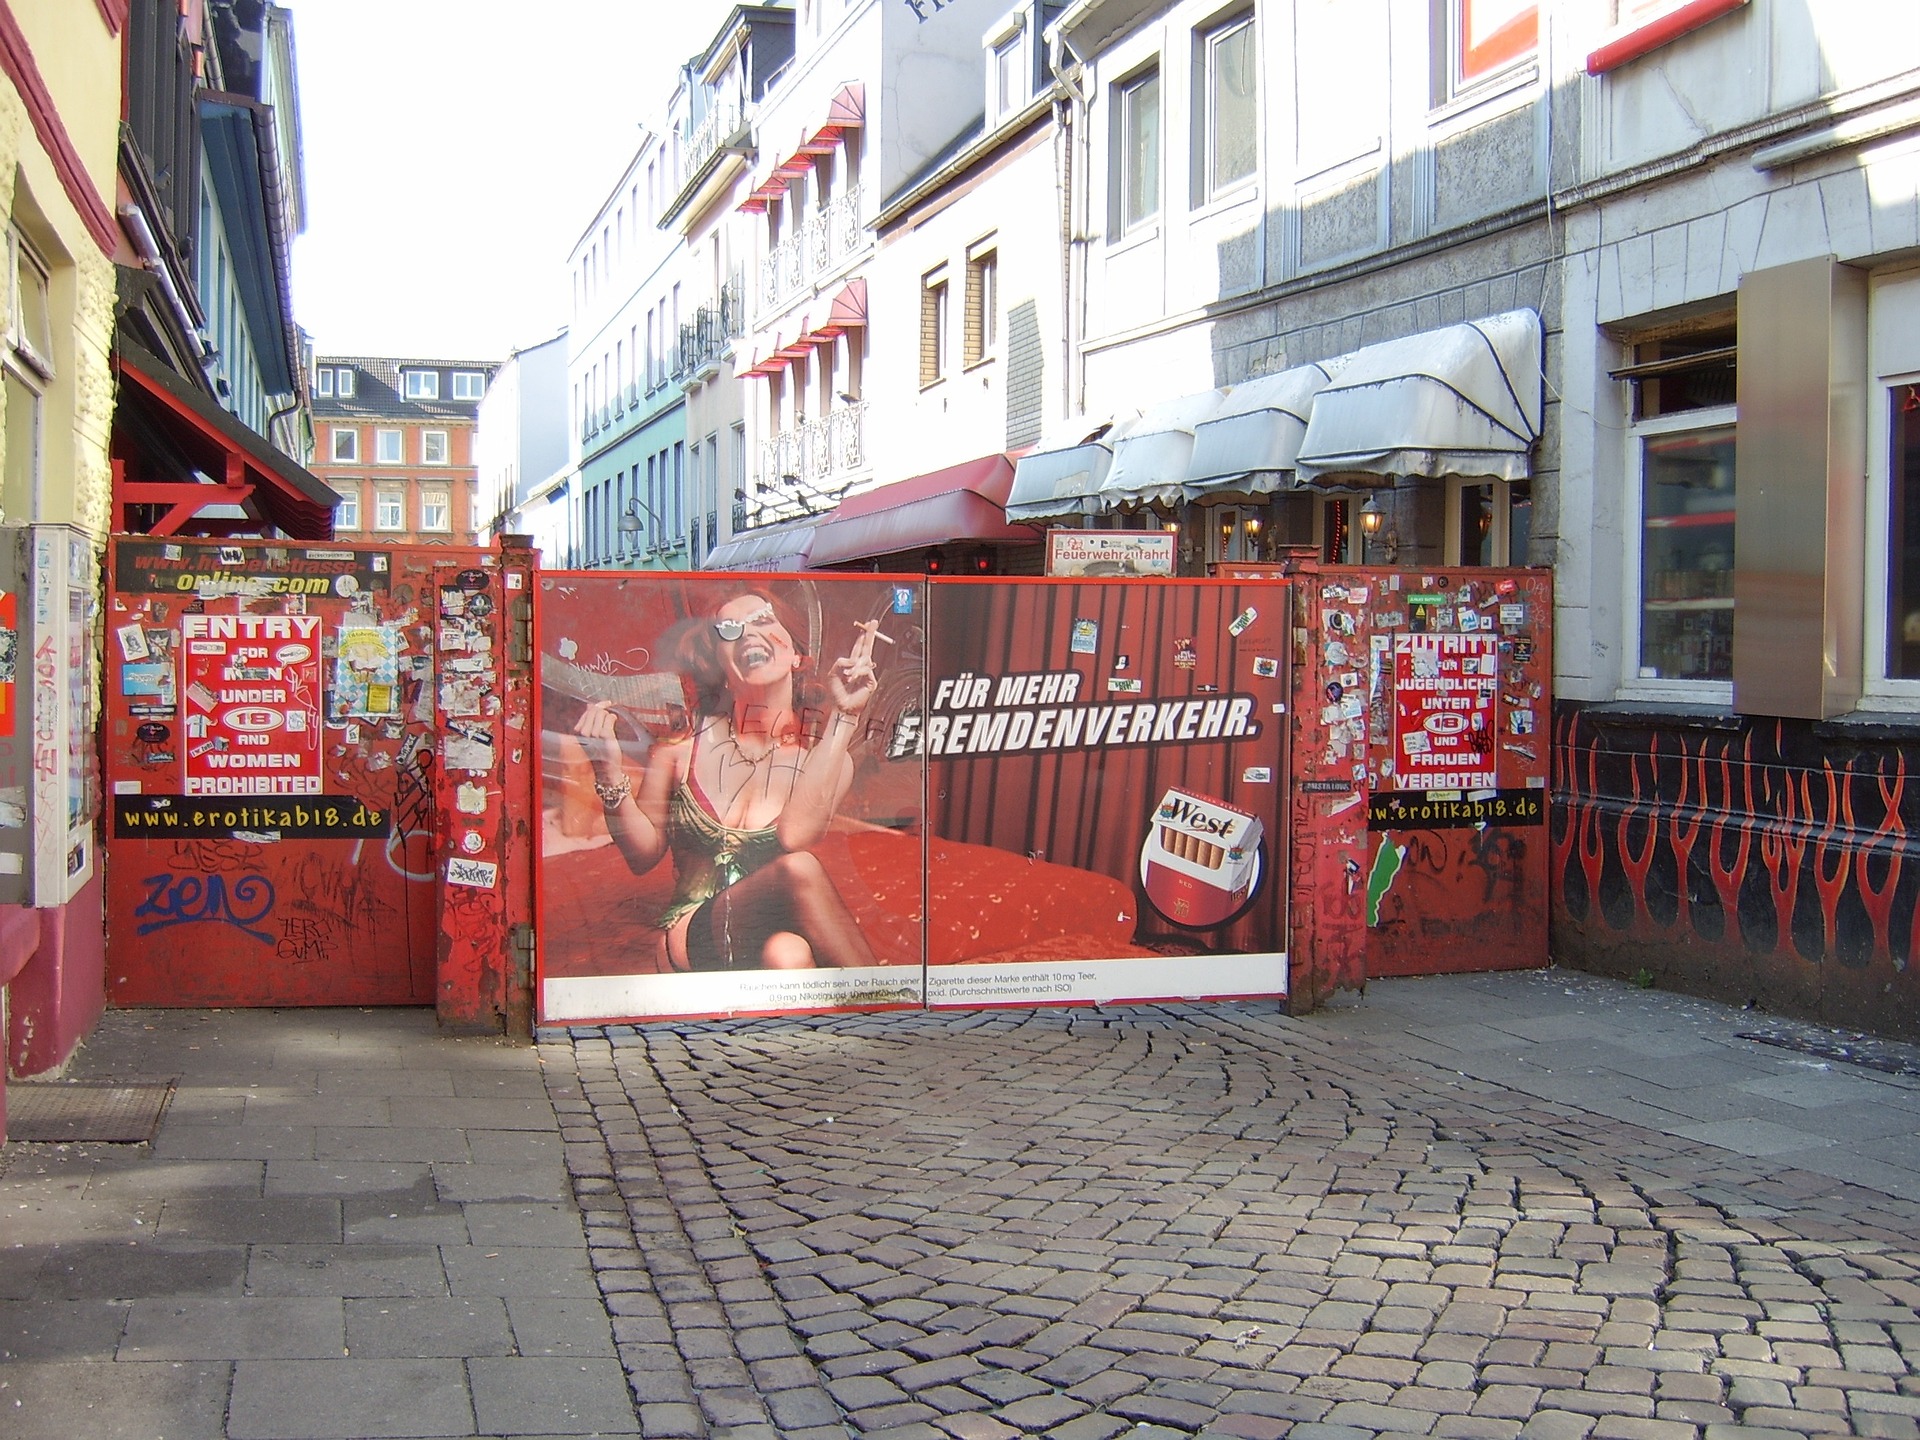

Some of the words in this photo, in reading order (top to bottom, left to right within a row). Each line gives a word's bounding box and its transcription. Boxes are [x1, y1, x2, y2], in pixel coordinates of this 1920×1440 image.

[1055, 549, 1170, 560] Feuerwehrzufahrt
[185, 617, 319, 639] ENTRY
[1396, 636, 1497, 654] ZUTRITT
[239, 647, 268, 658] FOR
[225, 667, 282, 680] MN
[1396, 678, 1497, 690] JUGENDLICHE
[221, 690, 286, 702] UNDER
[934, 673, 991, 710] FÜR
[994, 673, 1080, 707] MEHR
[1422, 698, 1470, 709] UNTER
[236, 712, 271, 725] 18
[1433, 718, 1459, 728] 18
[894, 699, 1257, 756] FREMDENVERKEHR.
[238, 735, 269, 745] AND
[1433, 737, 1457, 746] UND
[208, 754, 300, 768] WOMEN
[1410, 754, 1480, 766] FRAUEN
[186, 777, 321, 794] PROHIBITED
[1396, 773, 1496, 788] VERBOTEN
[124, 805, 382, 827] www.erotikab18.de
[1171, 797, 1236, 839] West
[779, 982, 801, 990] kann
[803, 979, 830, 988] tödlich
[832, 978, 851, 988] sein.
[855, 978, 869, 987] Der
[871, 977, 898, 987] Rauch
[900, 977, 920, 986] einer
[929, 976, 966, 987] Zigarette
[967, 975, 992, 984] dieser
[995, 975, 1020, 983] Marke
[1022, 973, 1050, 982] enthält
[1078, 972, 1097, 981] Teer,
[928, 989, 947, 997] oxid.
[950, 985, 1030, 997] (Durchschnittswerte
[1033, 984, 1052, 993] nach
[1054, 982, 1072, 993] ISO)
